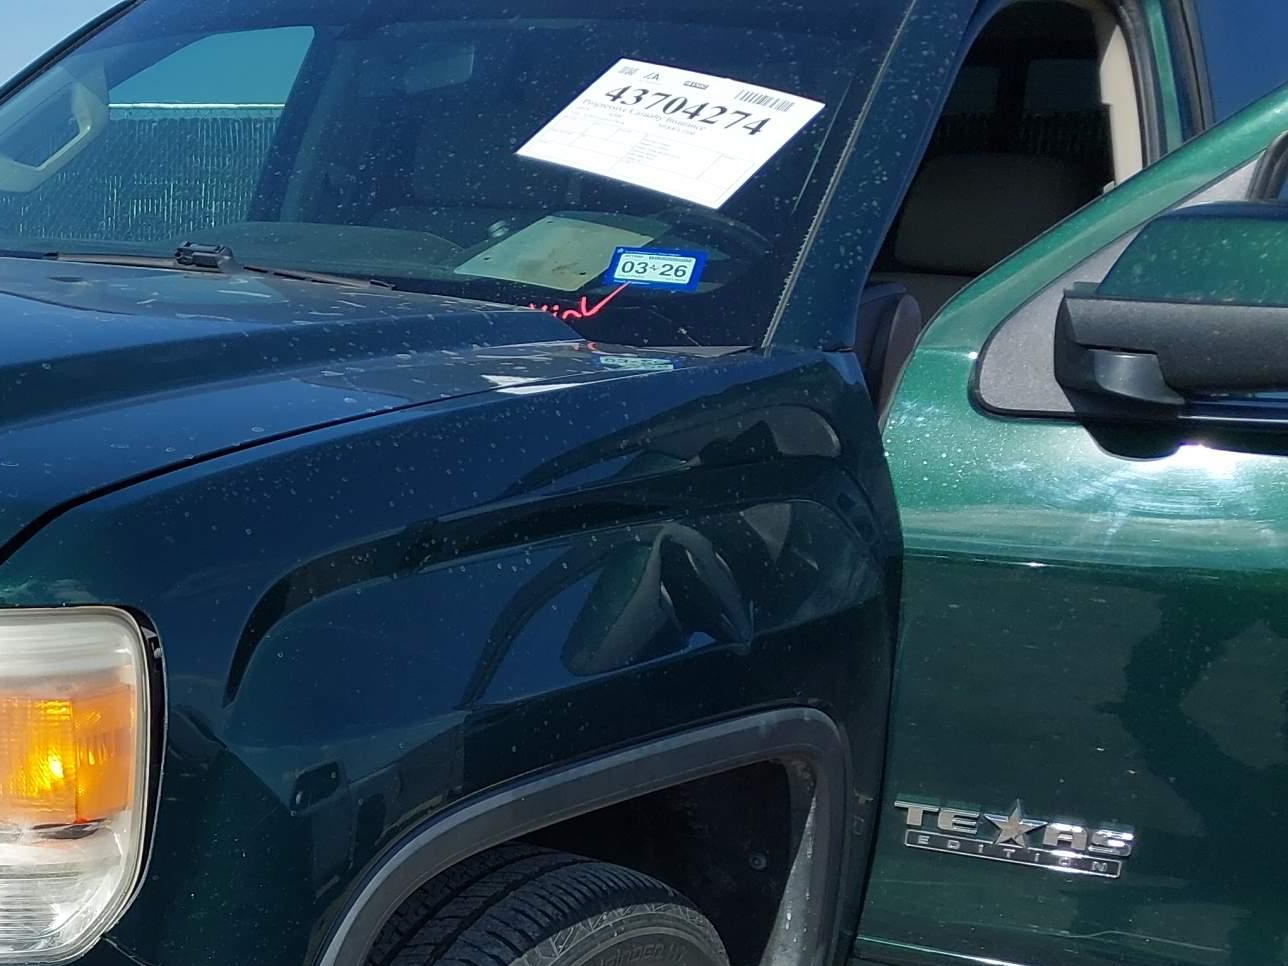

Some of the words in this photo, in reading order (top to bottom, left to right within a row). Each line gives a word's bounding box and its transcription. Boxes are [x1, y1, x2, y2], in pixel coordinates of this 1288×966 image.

[604, 84, 771, 136] 43704274
[621, 260, 649, 275] 03
[659, 263, 688, 278] 26
[915, 834, 1108, 872] EDITION
